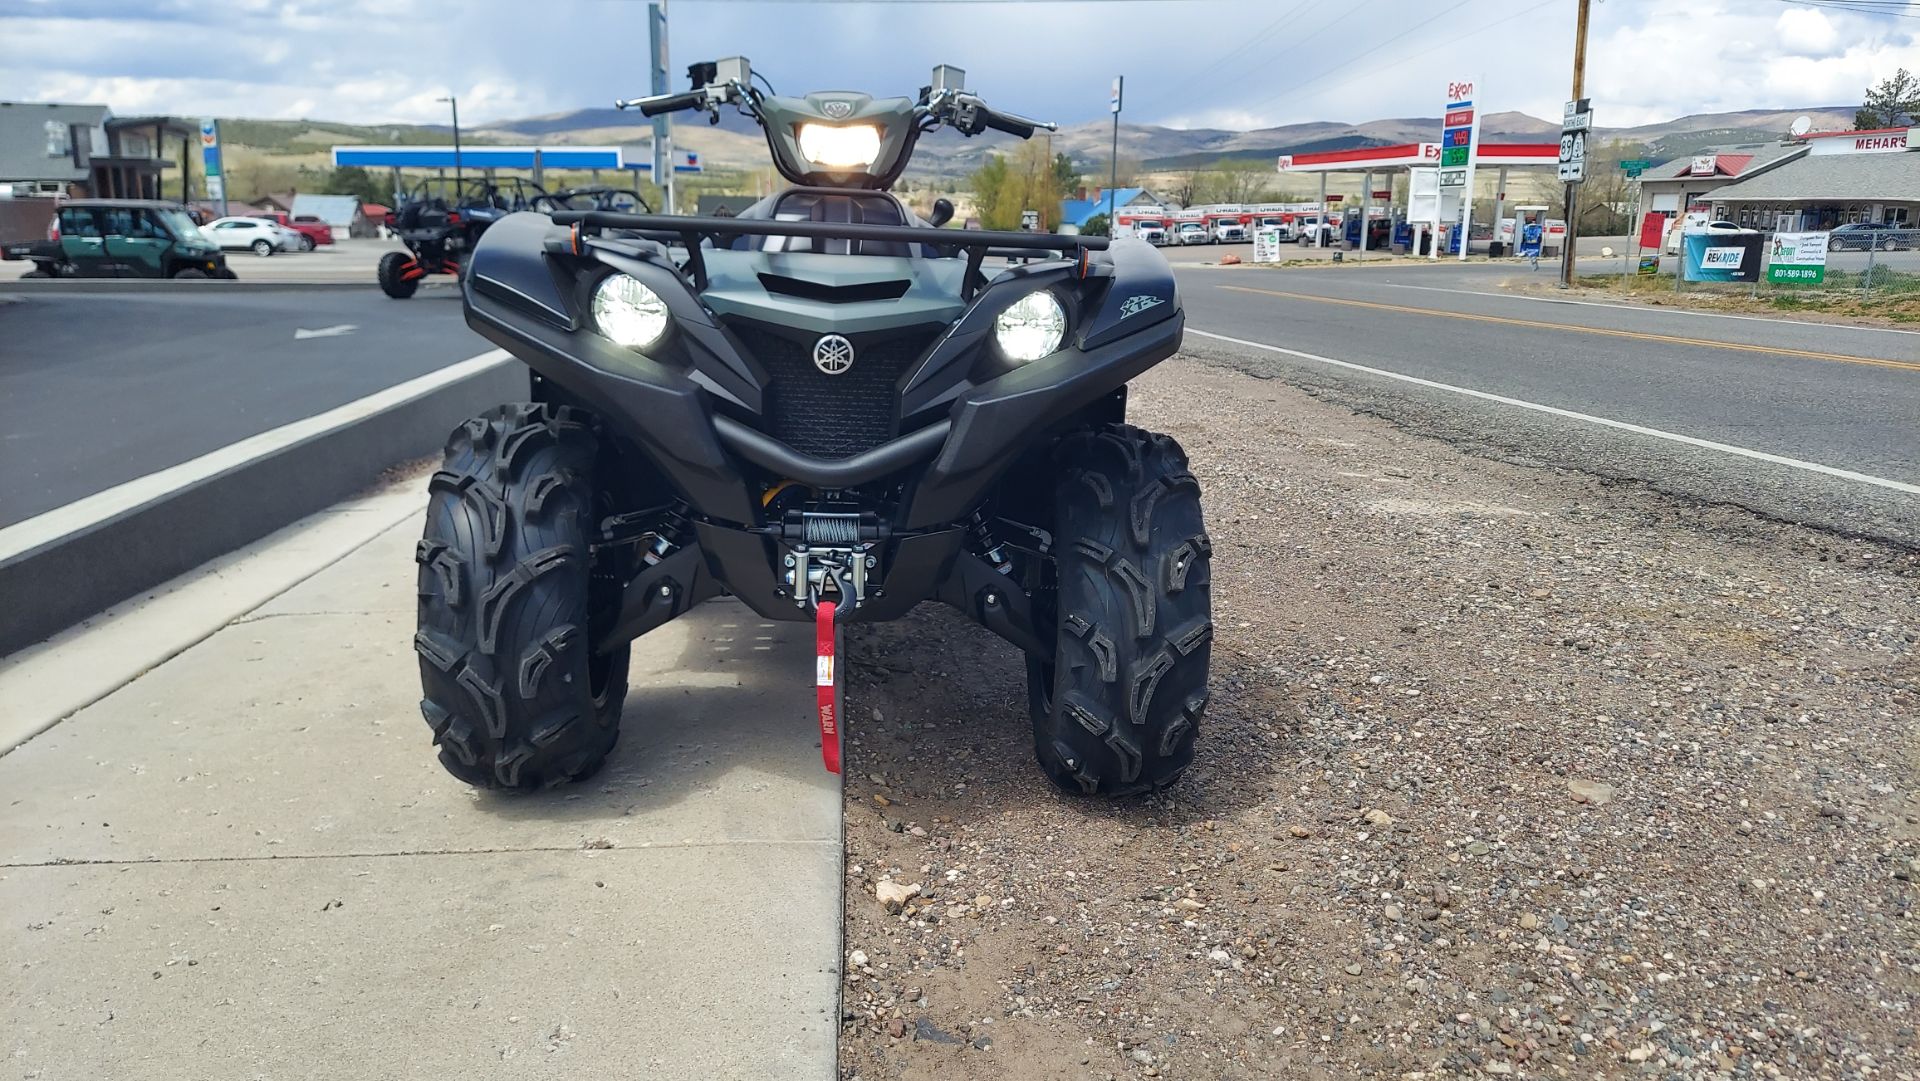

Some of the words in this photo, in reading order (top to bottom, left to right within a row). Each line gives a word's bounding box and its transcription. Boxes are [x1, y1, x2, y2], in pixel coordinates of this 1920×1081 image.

[1448, 82, 1473, 100] Exxon
[1576, 116, 1586, 127] EAST
[1561, 139, 1572, 155] 89
[1855, 136, 1907, 149] MEHAR'S
[820, 704, 835, 734] WARN
